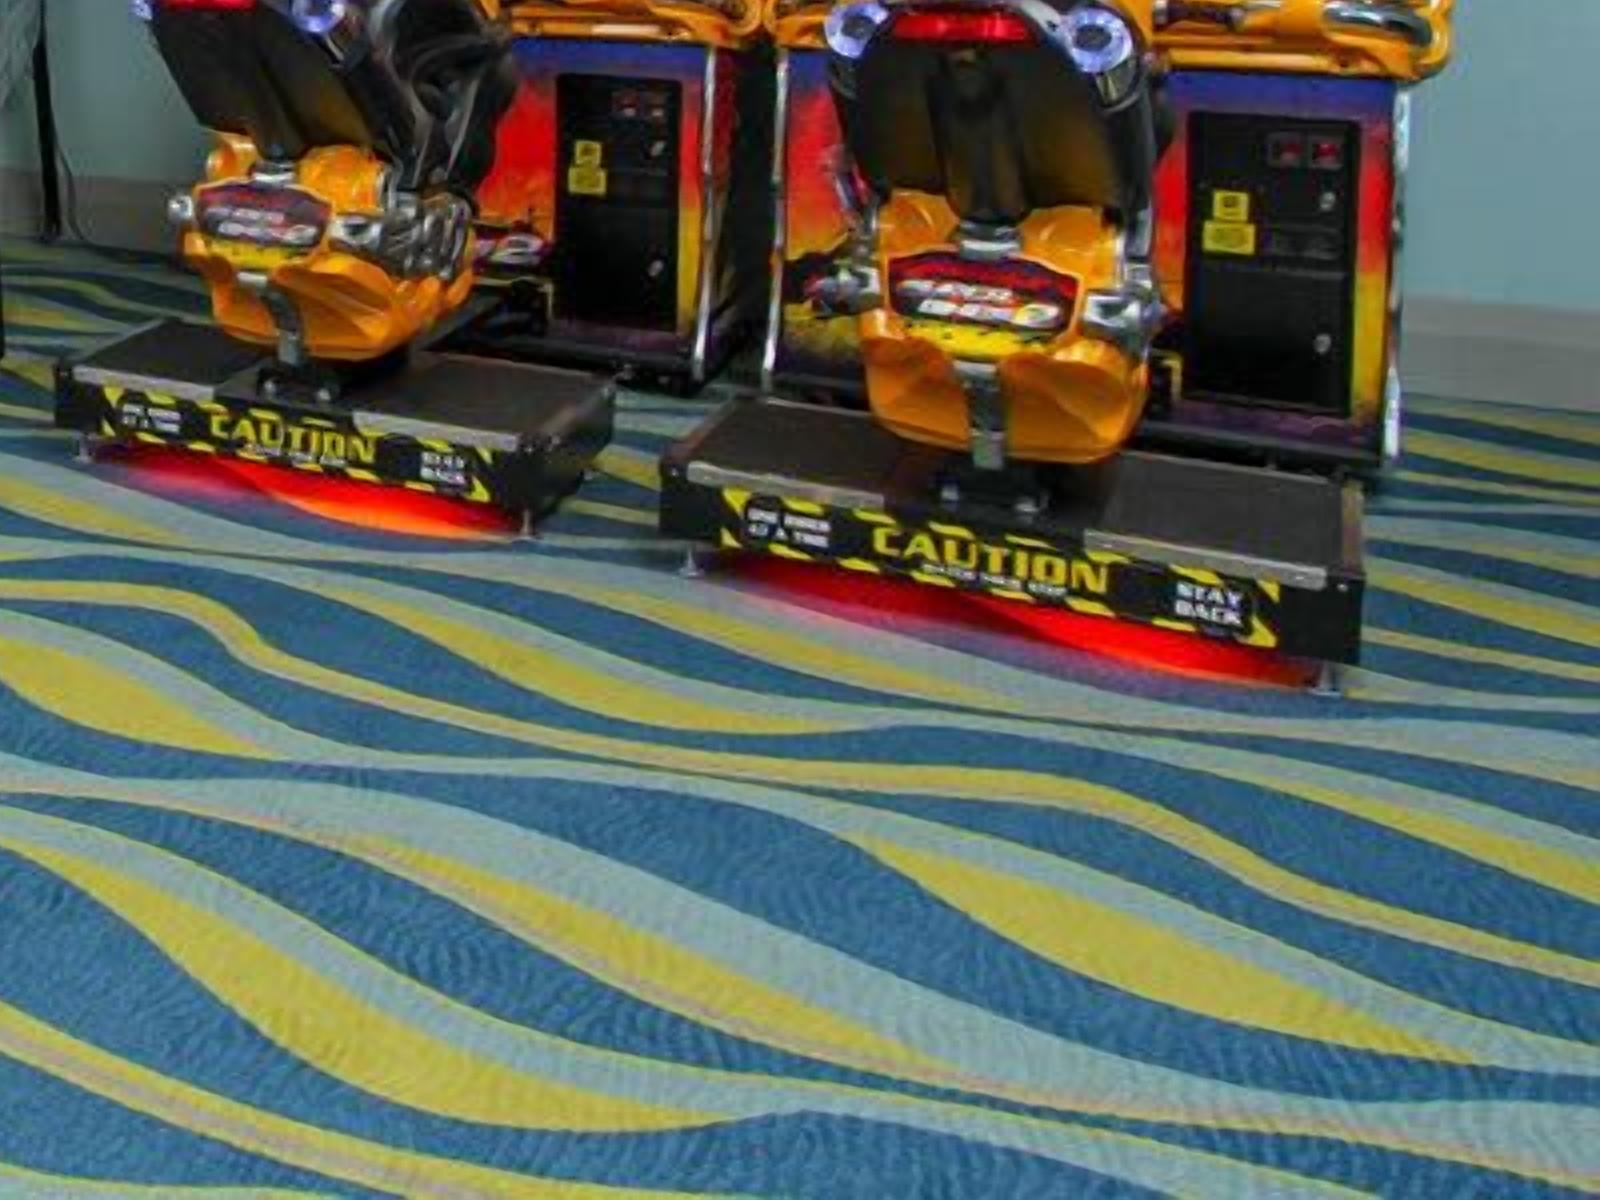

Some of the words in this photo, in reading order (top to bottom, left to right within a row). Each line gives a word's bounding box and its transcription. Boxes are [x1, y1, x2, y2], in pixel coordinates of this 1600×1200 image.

[211, 414, 376, 464] CAUTION
[872, 526, 1109, 594] CAUTION
[1175, 599, 1243, 626] BACK
[1176, 581, 1242, 609] STAY
